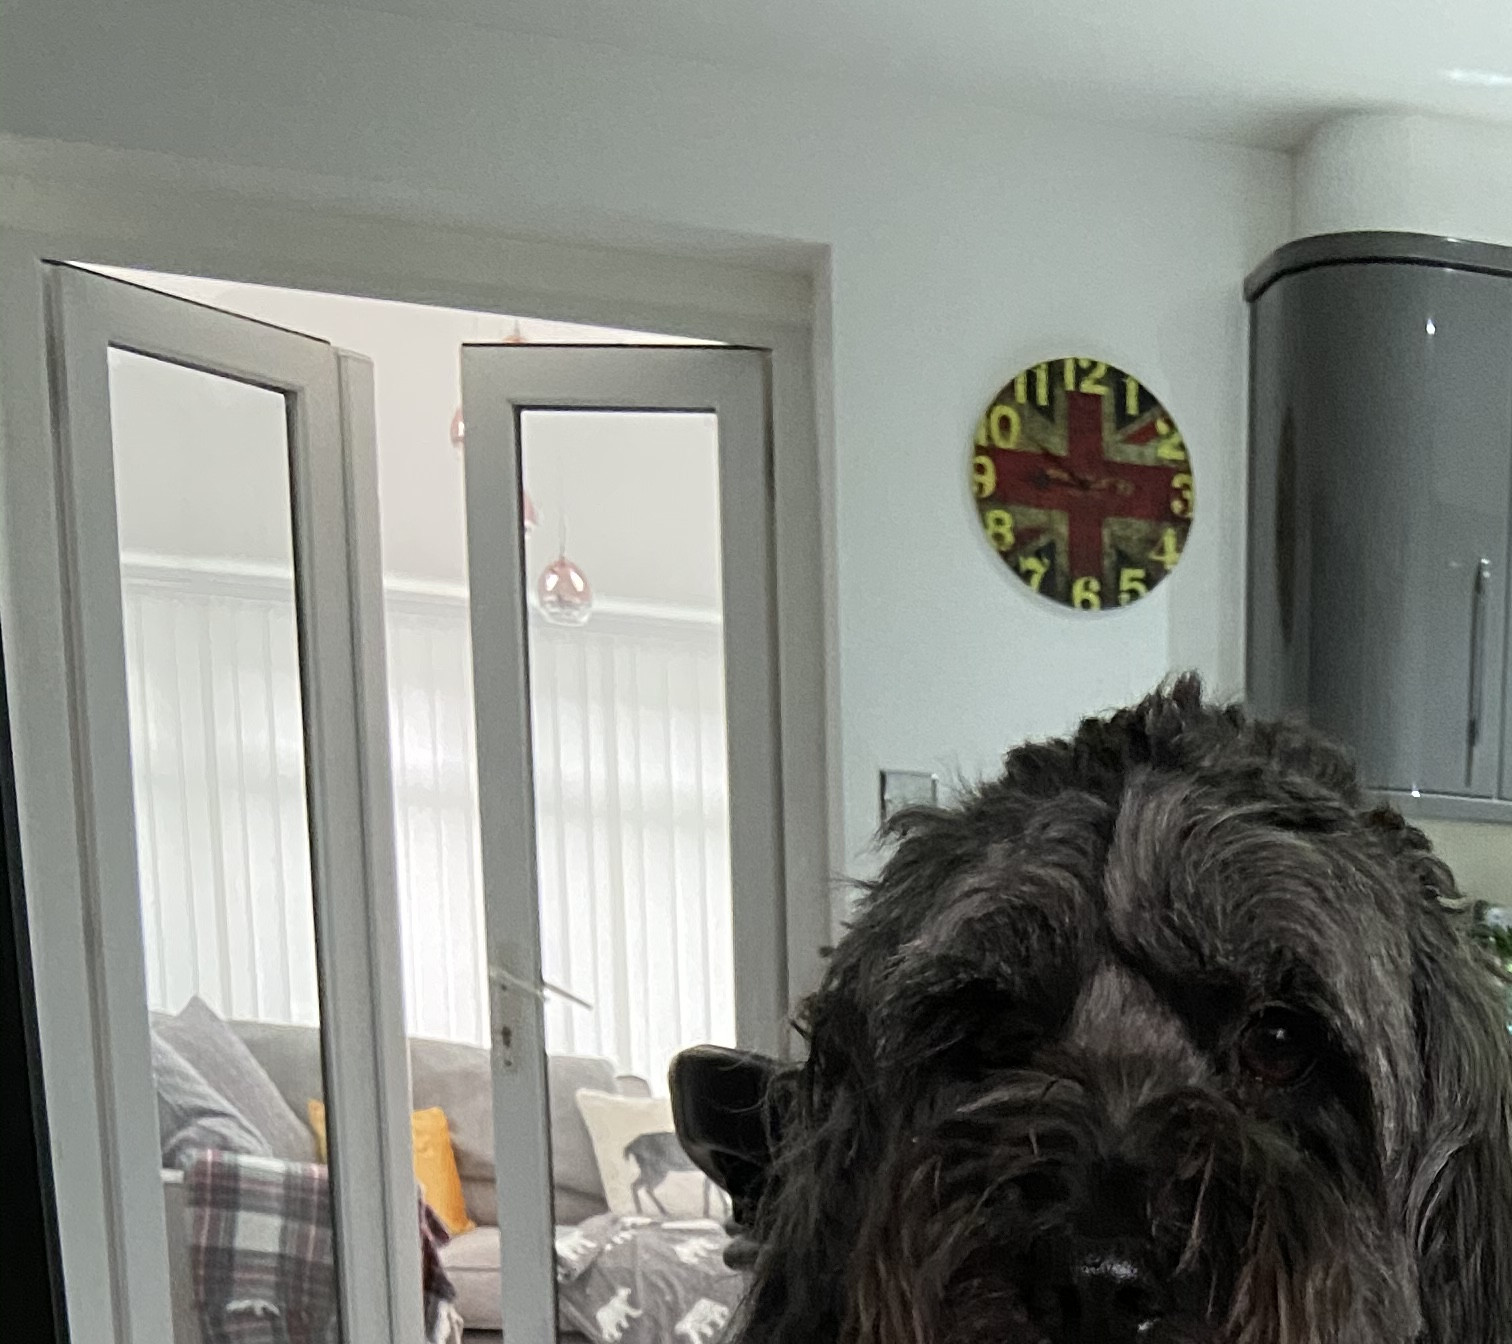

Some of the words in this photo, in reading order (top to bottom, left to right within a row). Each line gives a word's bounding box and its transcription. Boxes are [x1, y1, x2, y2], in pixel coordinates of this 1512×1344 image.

[1014, 363, 1049, 406] 11
[1064, 357, 1109, 395] 12
[1123, 377, 1140, 415] 1
[974, 405, 1022, 450] 10
[1155, 418, 1185, 461] 2
[972, 455, 997, 498] 9
[1170, 473, 1194, 518] 3
[986, 509, 1016, 552] 8
[1149, 527, 1180, 570] 4
[1019, 556, 1050, 592] 7
[1072, 576, 1101, 611] 6
[1118, 568, 1148, 605] 5
